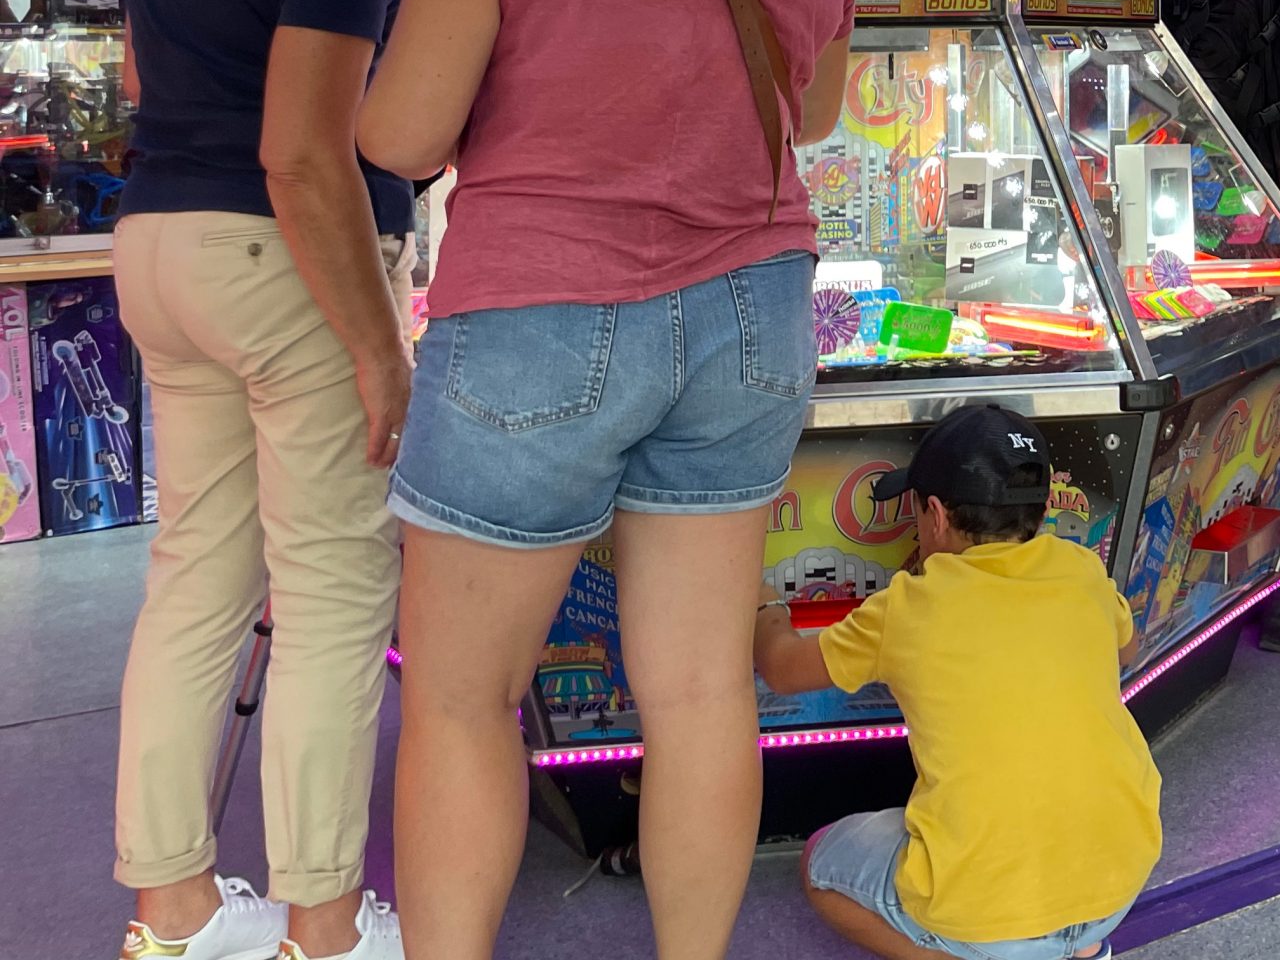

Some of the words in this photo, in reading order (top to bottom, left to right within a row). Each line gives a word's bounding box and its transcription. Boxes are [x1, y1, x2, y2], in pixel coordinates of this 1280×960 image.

[845, 58, 937, 127] City
[815, 230, 854, 239] CASINO
[818, 220, 850, 230] HOTEL
[1007, 432, 1038, 453] NY
[578, 562, 615, 587] USIC
[586, 578, 616, 599] HAL
